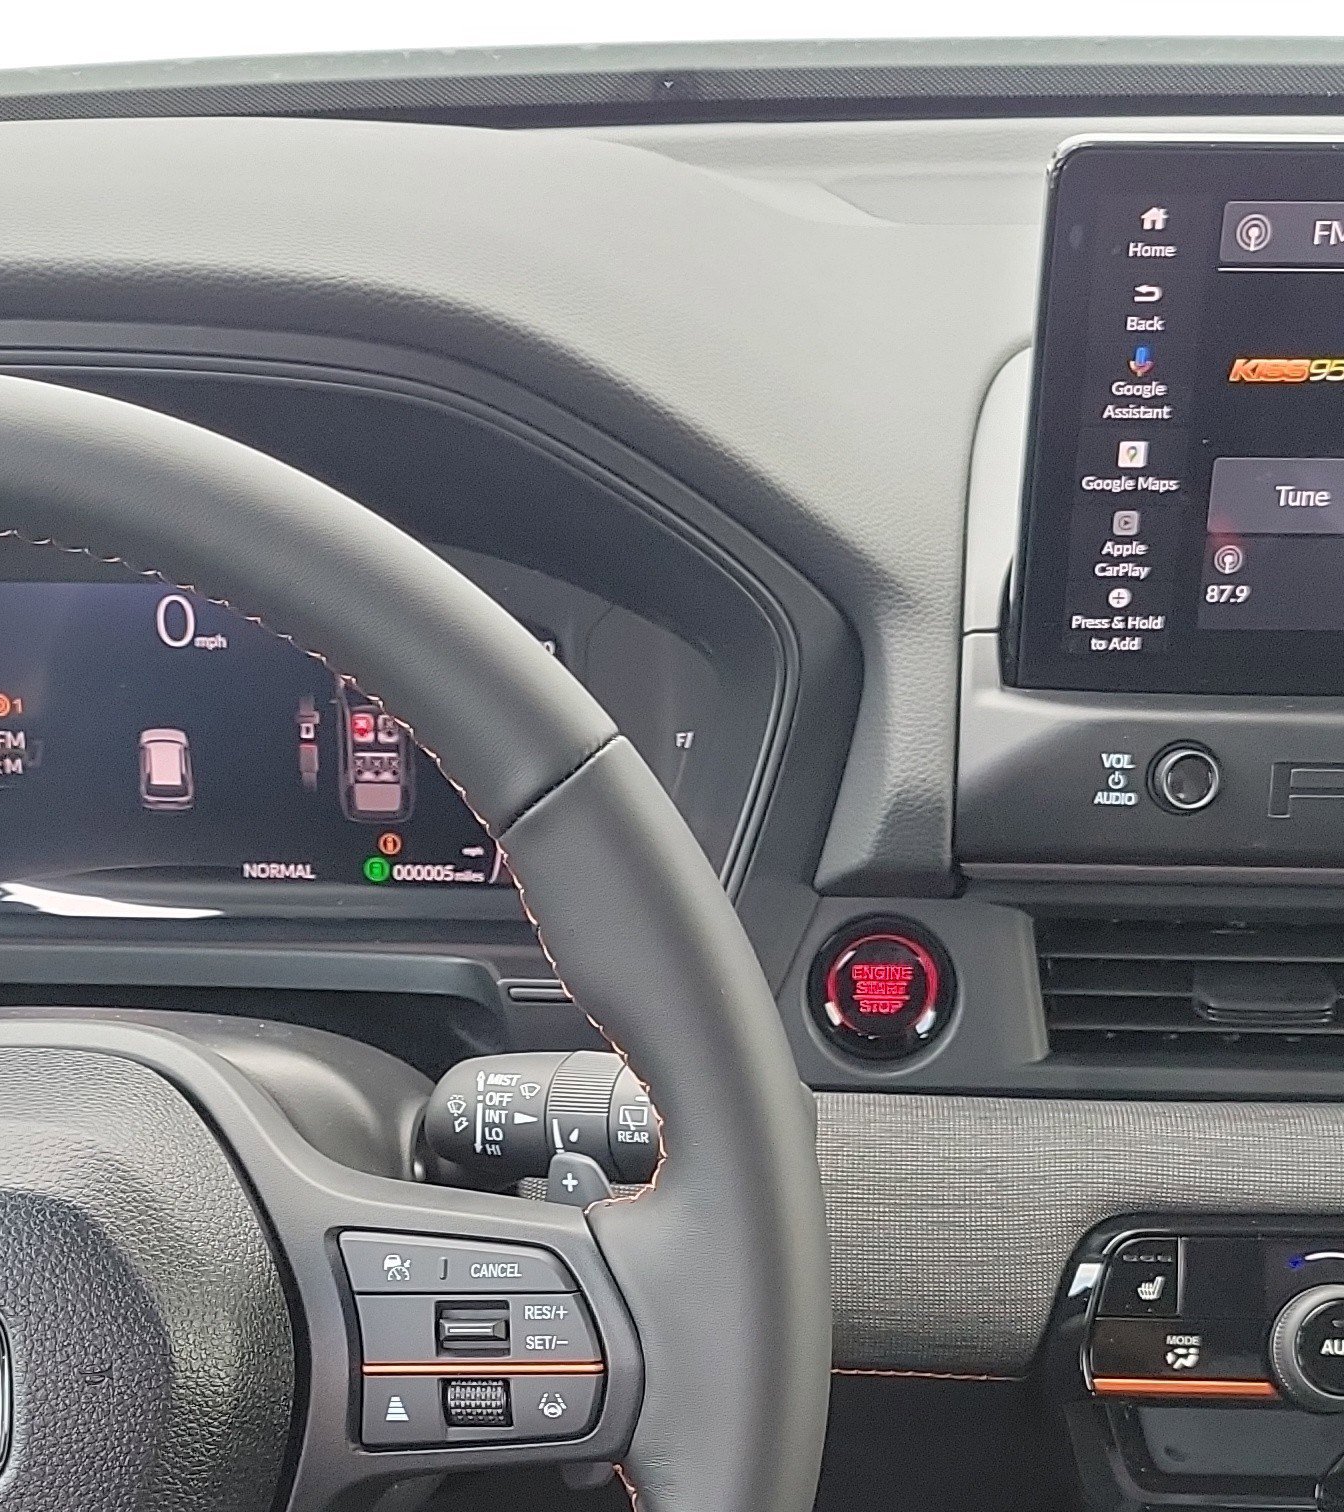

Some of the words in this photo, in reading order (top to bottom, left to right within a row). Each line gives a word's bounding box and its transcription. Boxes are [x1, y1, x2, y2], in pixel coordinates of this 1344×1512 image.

[1129, 243, 1176, 258] Home
[1127, 317, 1164, 332] Back
[1111, 381, 1167, 398] Google
[1103, 404, 1171, 419] Assistant
[1082, 477, 1135, 492] Google
[1138, 477, 1179, 492] Maps
[1276, 486, 1330, 507] Tune
[1102, 541, 1148, 558] Apple
[1094, 563, 1151, 580] CarPlay
[1206, 585, 1249, 603] 87.9
[157, 595, 195, 647] 0
[1072, 616, 1110, 630] Press
[1112, 616, 1125, 630] &
[1127, 616, 1164, 630] Hold
[1091, 637, 1106, 651] to
[1108, 637, 1141, 651] Add
[6, 758, 24, 774] M
[1101, 753, 1136, 769] VOL
[1094, 791, 1137, 805] AUDIO
[243, 863, 317, 880] NORMAL
[393, 864, 455, 881] 000005
[852, 965, 914, 980] ENGINE
[856, 981, 908, 994] START
[859, 1001, 903, 1013] STOP
[486, 1073, 522, 1087] MIST
[486, 1092, 514, 1106] OFF
[485, 1110, 508, 1125] INT
[485, 1127, 504, 1141] LO
[617, 1130, 649, 1143] REAR
[486, 1144, 501, 1156] HI
[470, 1263, 522, 1279] CANCEL
[1166, 1336, 1199, 1347] MODE
